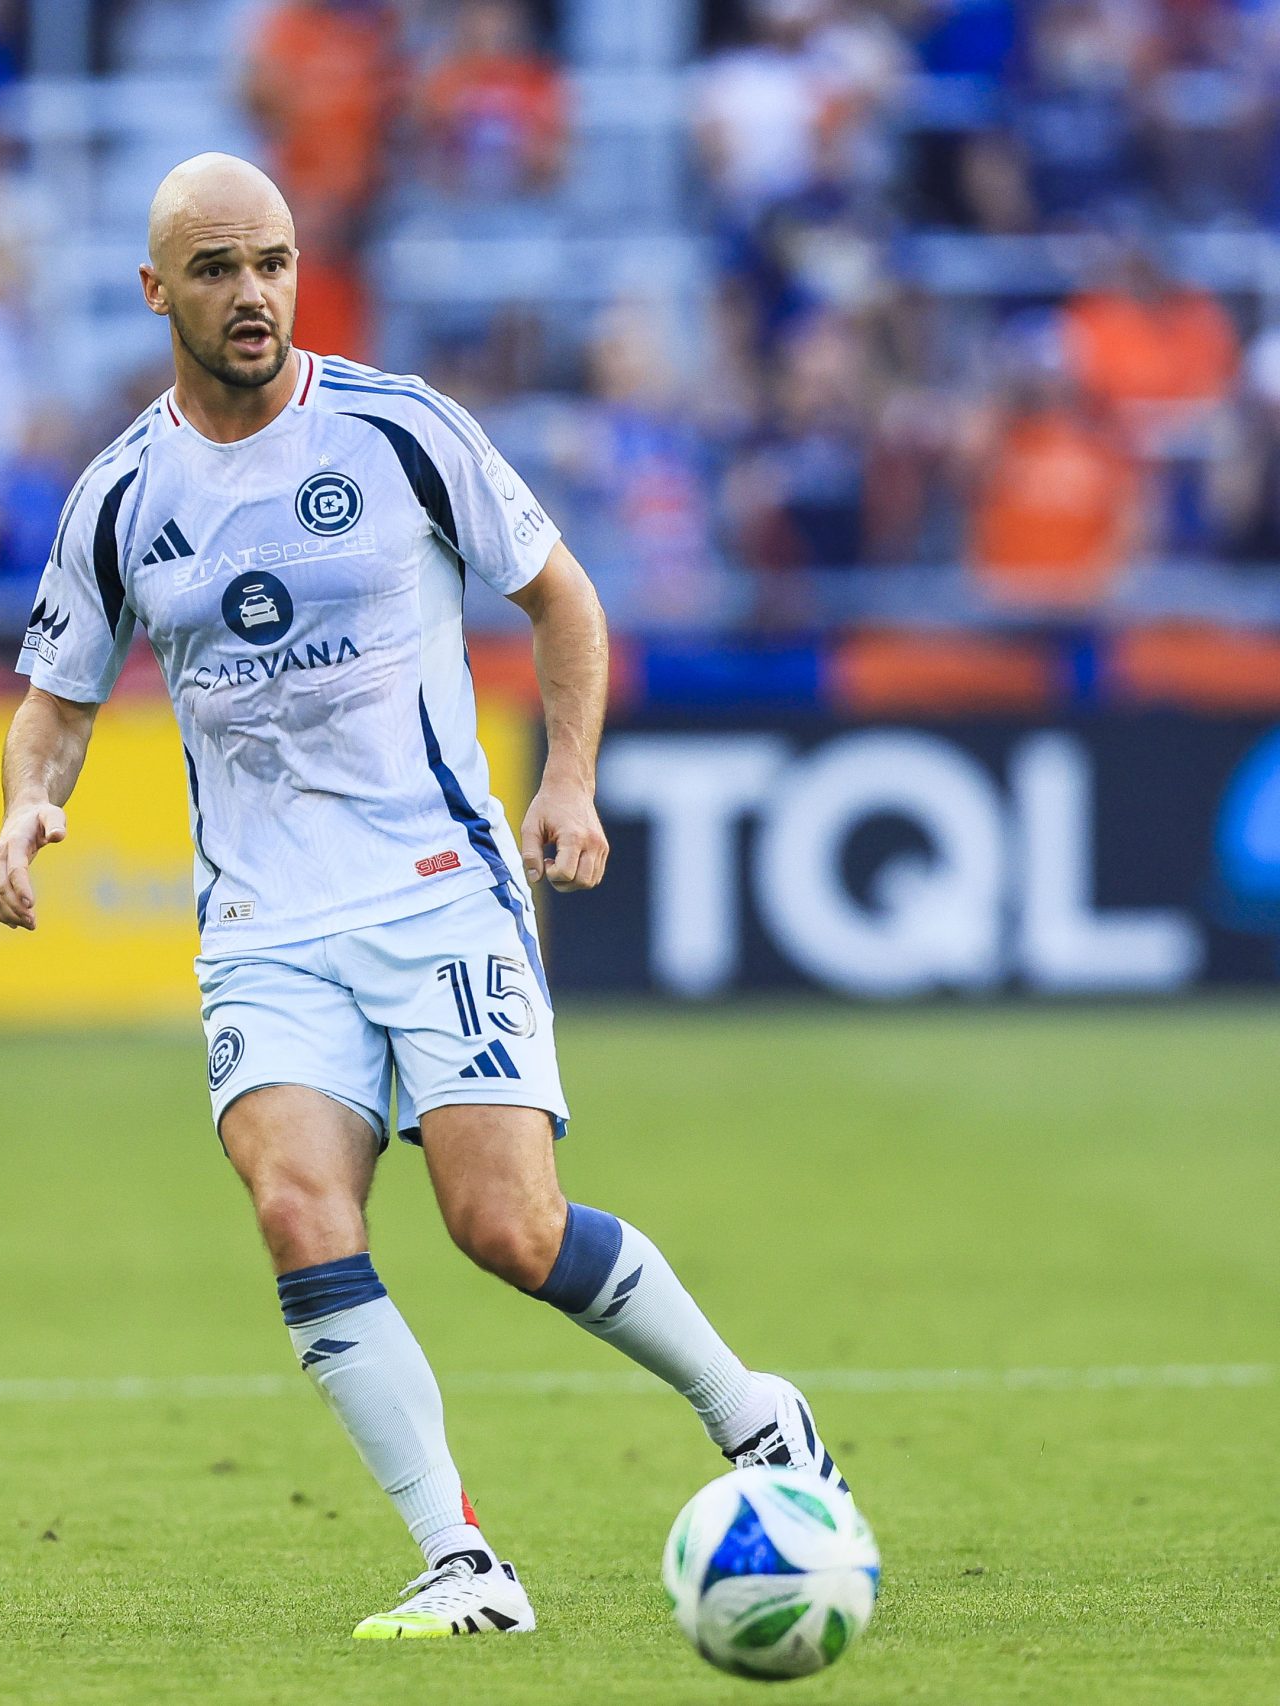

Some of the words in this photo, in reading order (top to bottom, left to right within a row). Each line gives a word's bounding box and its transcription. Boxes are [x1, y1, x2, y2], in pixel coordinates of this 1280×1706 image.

[522, 502, 544, 532] tv
[173, 527, 376, 588] STATSports
[193, 636, 361, 690] CARVANA
[415, 850, 461, 877] 312
[596, 726, 1207, 996] TQL
[436, 954, 537, 1039] 15
